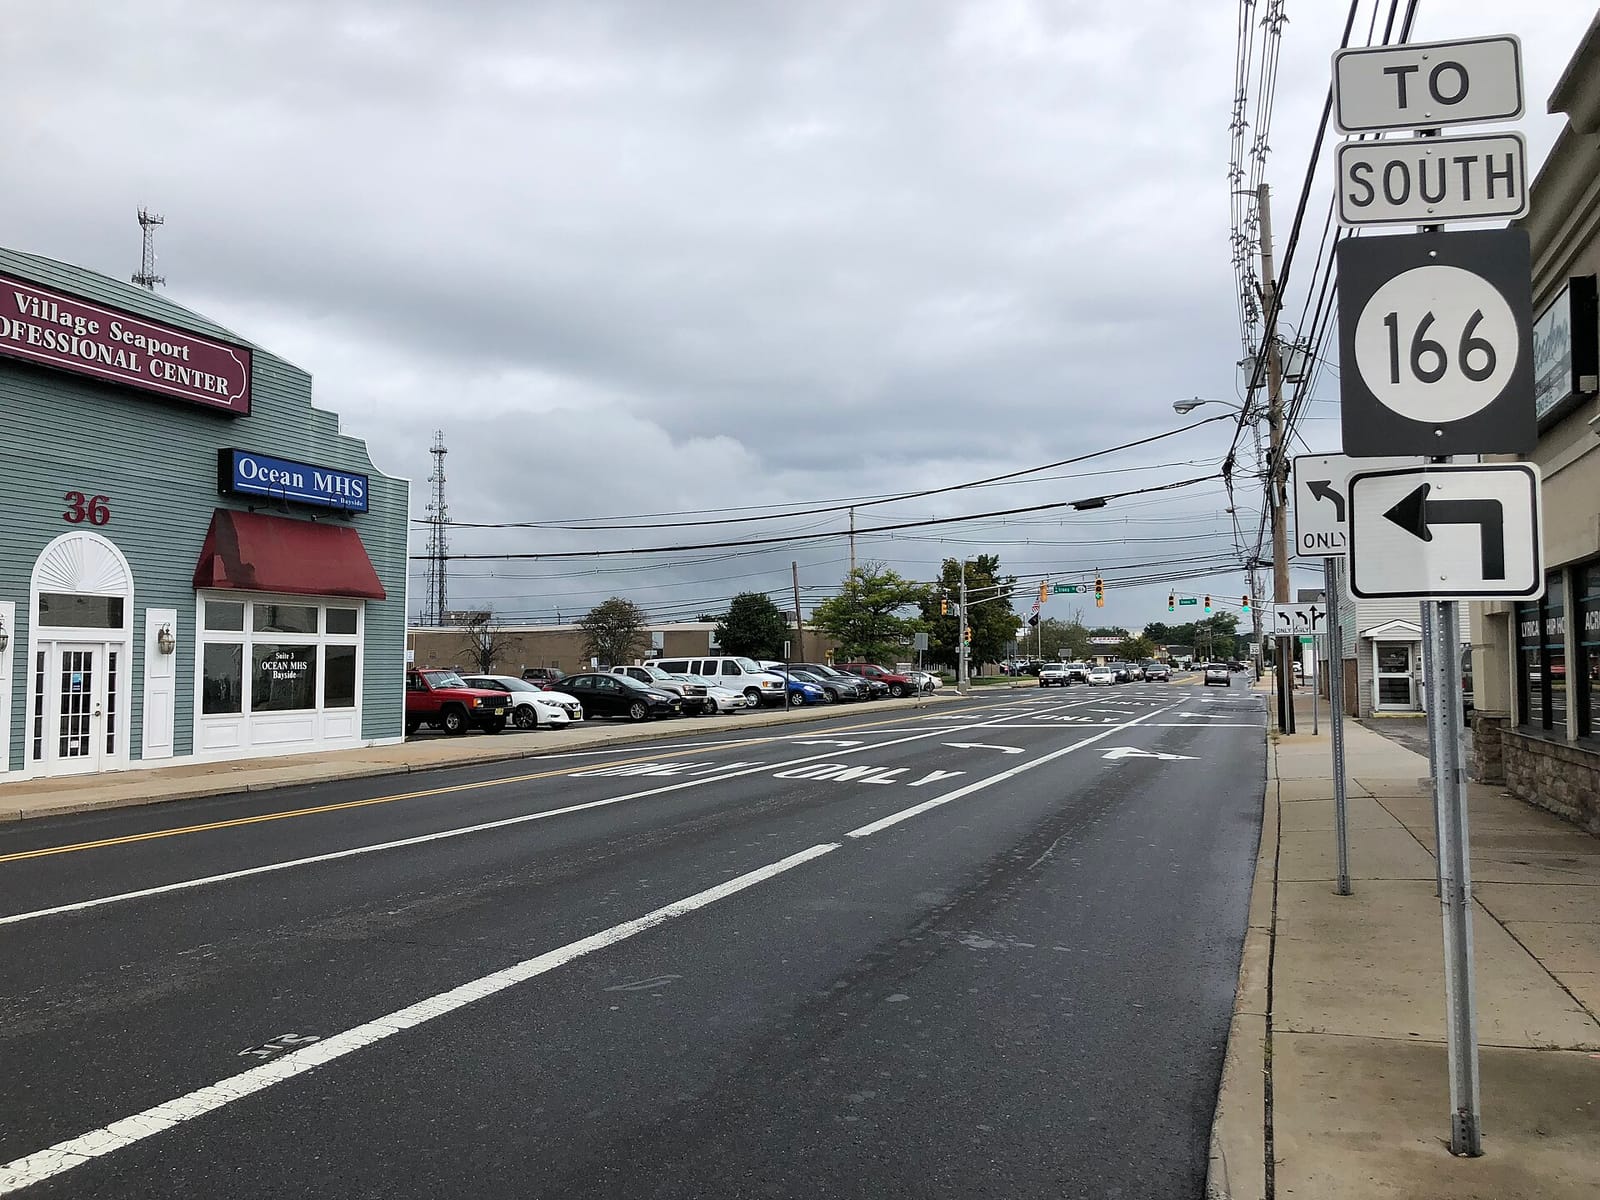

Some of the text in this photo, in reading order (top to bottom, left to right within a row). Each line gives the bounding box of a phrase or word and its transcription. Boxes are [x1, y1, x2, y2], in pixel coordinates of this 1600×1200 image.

[1383, 61, 1470, 109] TO
[1349, 152, 1515, 208] SOUTH
[13, 291, 190, 361] Village Seaport
[1383, 308, 1497, 384] 166
[149, 358, 229, 396] CENTER
[238, 457, 363, 499] Ocean MHS
[63, 491, 110, 526] 36
[340, 497, 363, 507] Bayside
[1546, 618, 1556, 635] HIP
[1585, 609, 1600, 631] ACR
[261, 661, 308, 670] OCEAN MHS
[291, 652, 295, 660] 3
[272, 670, 297, 680] Bayside
[1031, 714, 1121, 724] ONLY
[773, 763, 968, 787] ONLY
